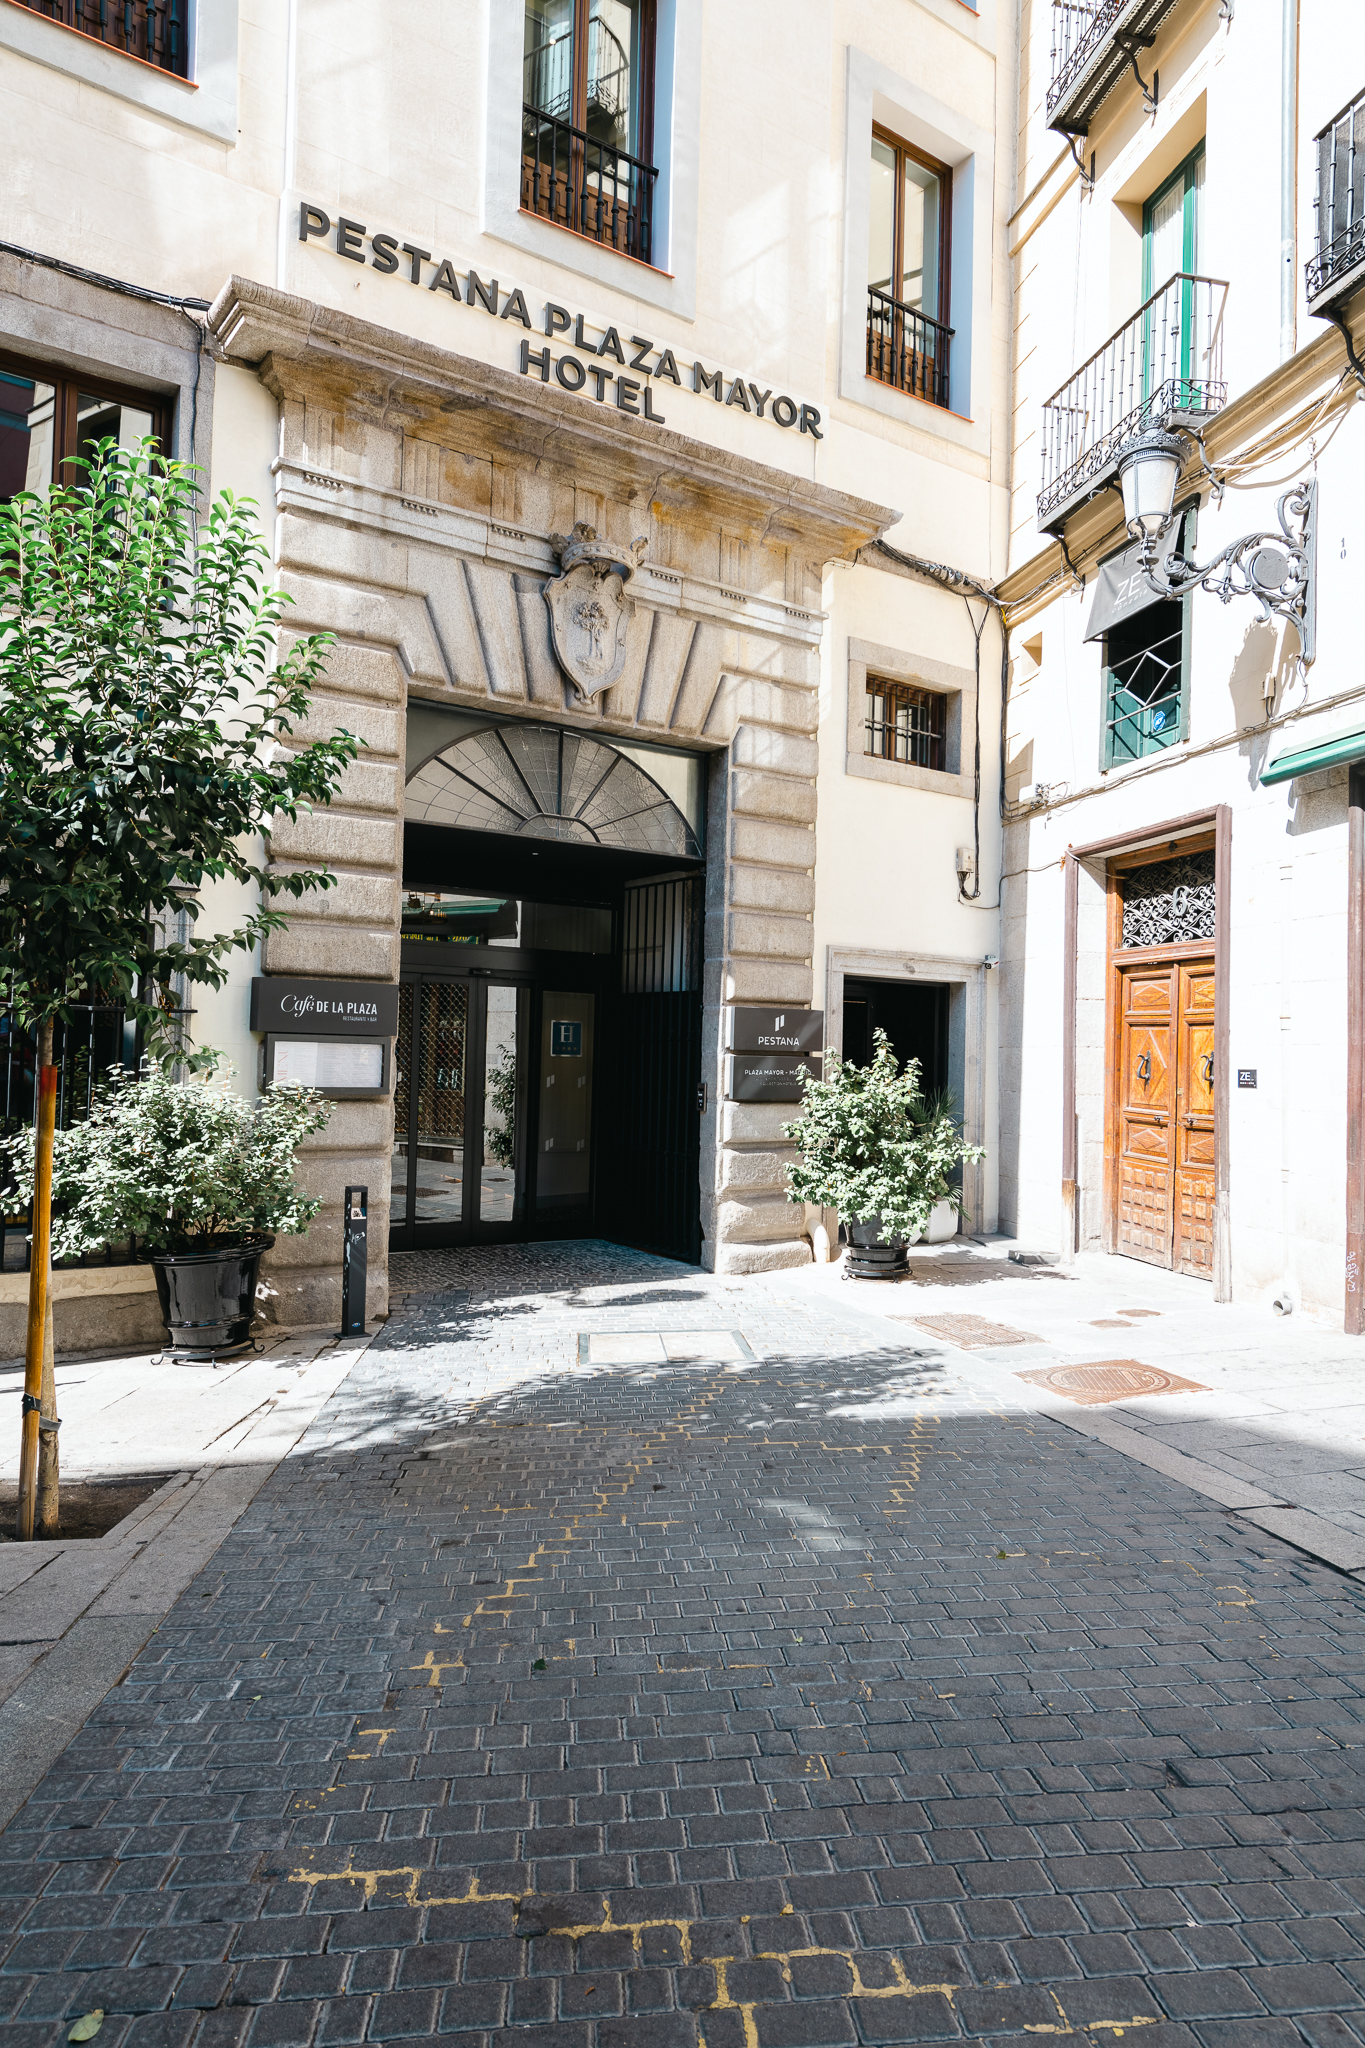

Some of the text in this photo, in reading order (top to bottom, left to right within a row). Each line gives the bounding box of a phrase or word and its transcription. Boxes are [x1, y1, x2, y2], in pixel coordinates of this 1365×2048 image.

[298, 201, 824, 440] PESTANA PLAZA MAYOR
[519, 338, 666, 425] HOTEL
[1172, 885, 1194, 917] 6
[280, 994, 378, 1018] Café DE LA PLAZA
[558, 1025, 575, 1043] H
[757, 1036, 800, 1046] PESTANA
